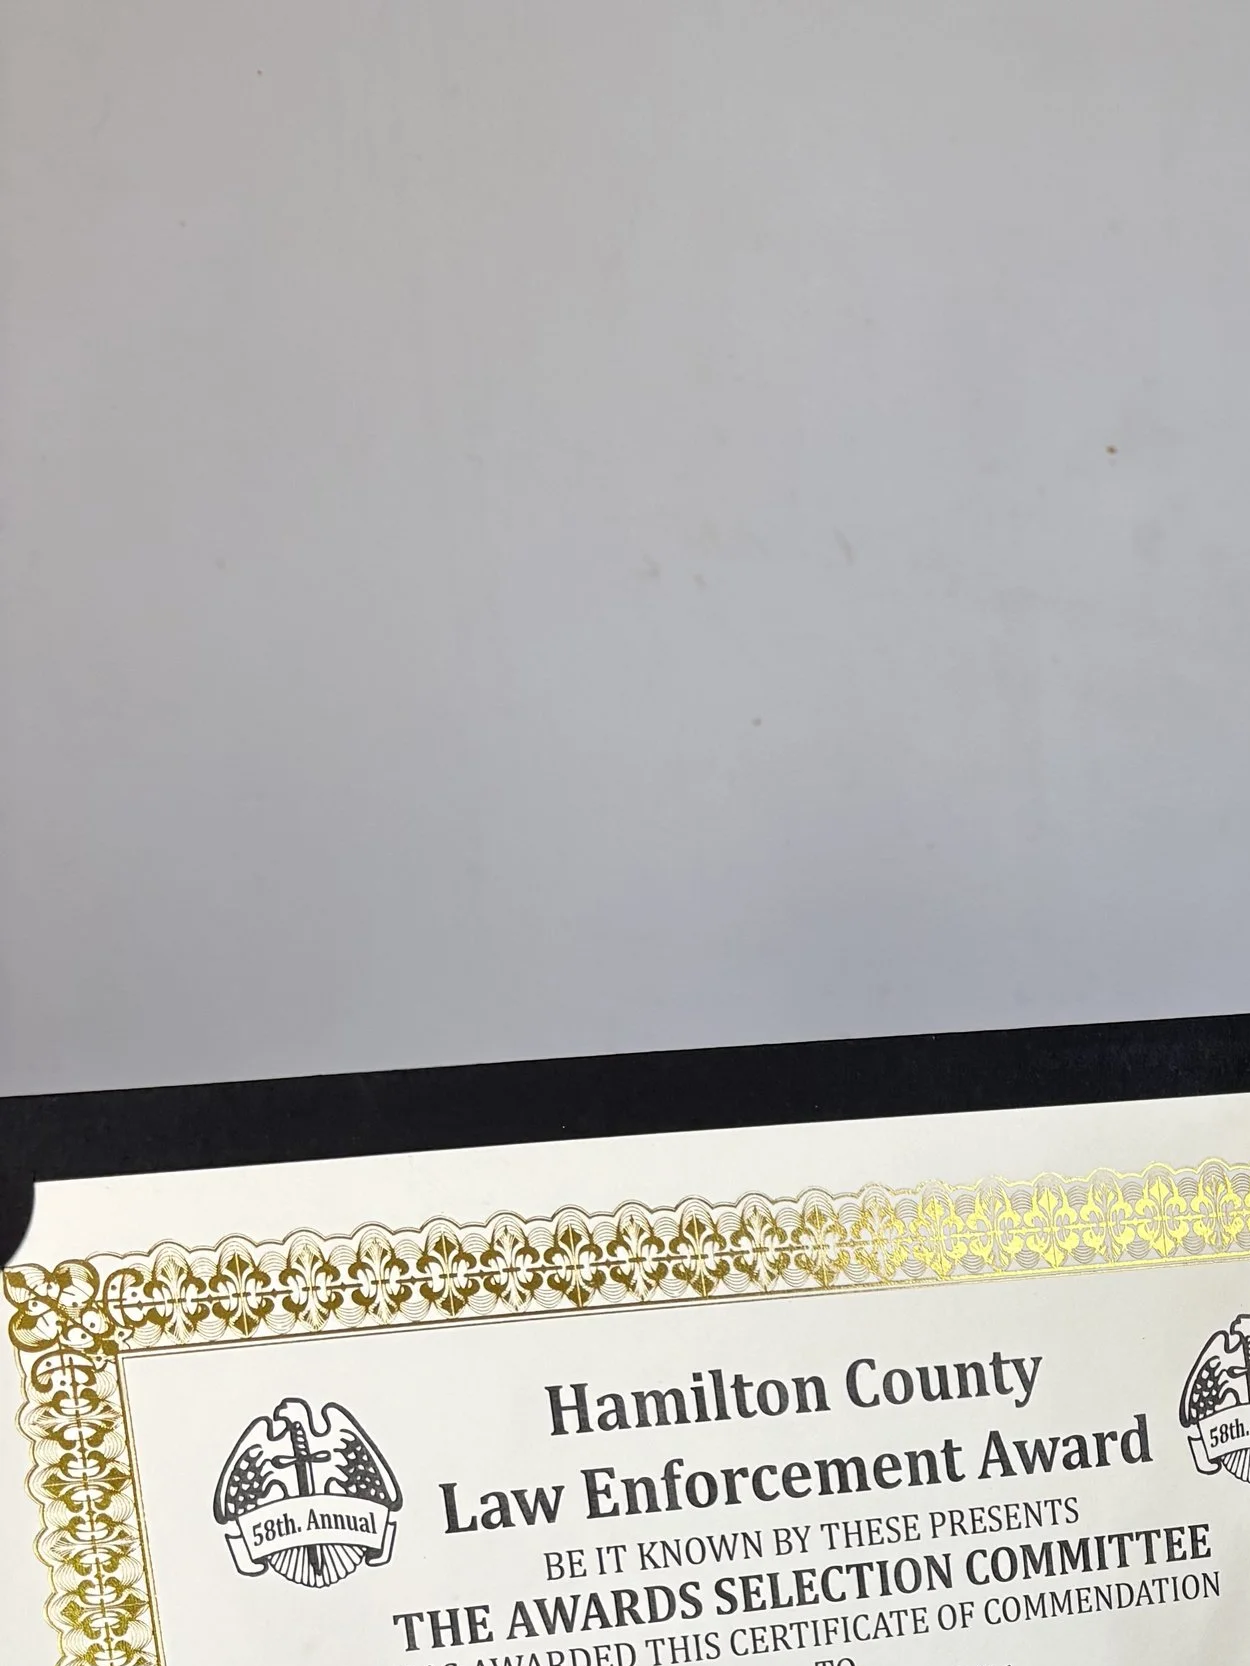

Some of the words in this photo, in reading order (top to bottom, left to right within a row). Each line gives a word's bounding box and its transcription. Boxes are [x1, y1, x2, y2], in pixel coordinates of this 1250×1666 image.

[544, 1369, 831, 1436] Hamilton
[846, 1352, 1043, 1408] County
[1210, 1418, 1249, 1448] 58th.
[438, 1483, 565, 1534] Law
[580, 1439, 966, 1519] Enforcement
[978, 1413, 1153, 1479] Award
[253, 1513, 301, 1546] 58th.
[306, 1509, 377, 1534] Annual
[544, 1549, 587, 1581] BE
[595, 1545, 627, 1575] IT
[637, 1531, 762, 1570] KNOWN
[772, 1525, 811, 1556] BY
[820, 1514, 920, 1550] THESE
[929, 1497, 1079, 1539] PRESENTS
[393, 1605, 494, 1652] THE
[506, 1581, 703, 1640] AWARDS
[714, 1553, 952, 1615] SELECTION
[966, 1524, 1211, 1585] COMMITTEE
[645, 1632, 721, 1666] THIS
[730, 1607, 929, 1656] CERTIFICATE
[938, 1601, 974, 1630] OF
[984, 1571, 1219, 1625] COMMENDATION
